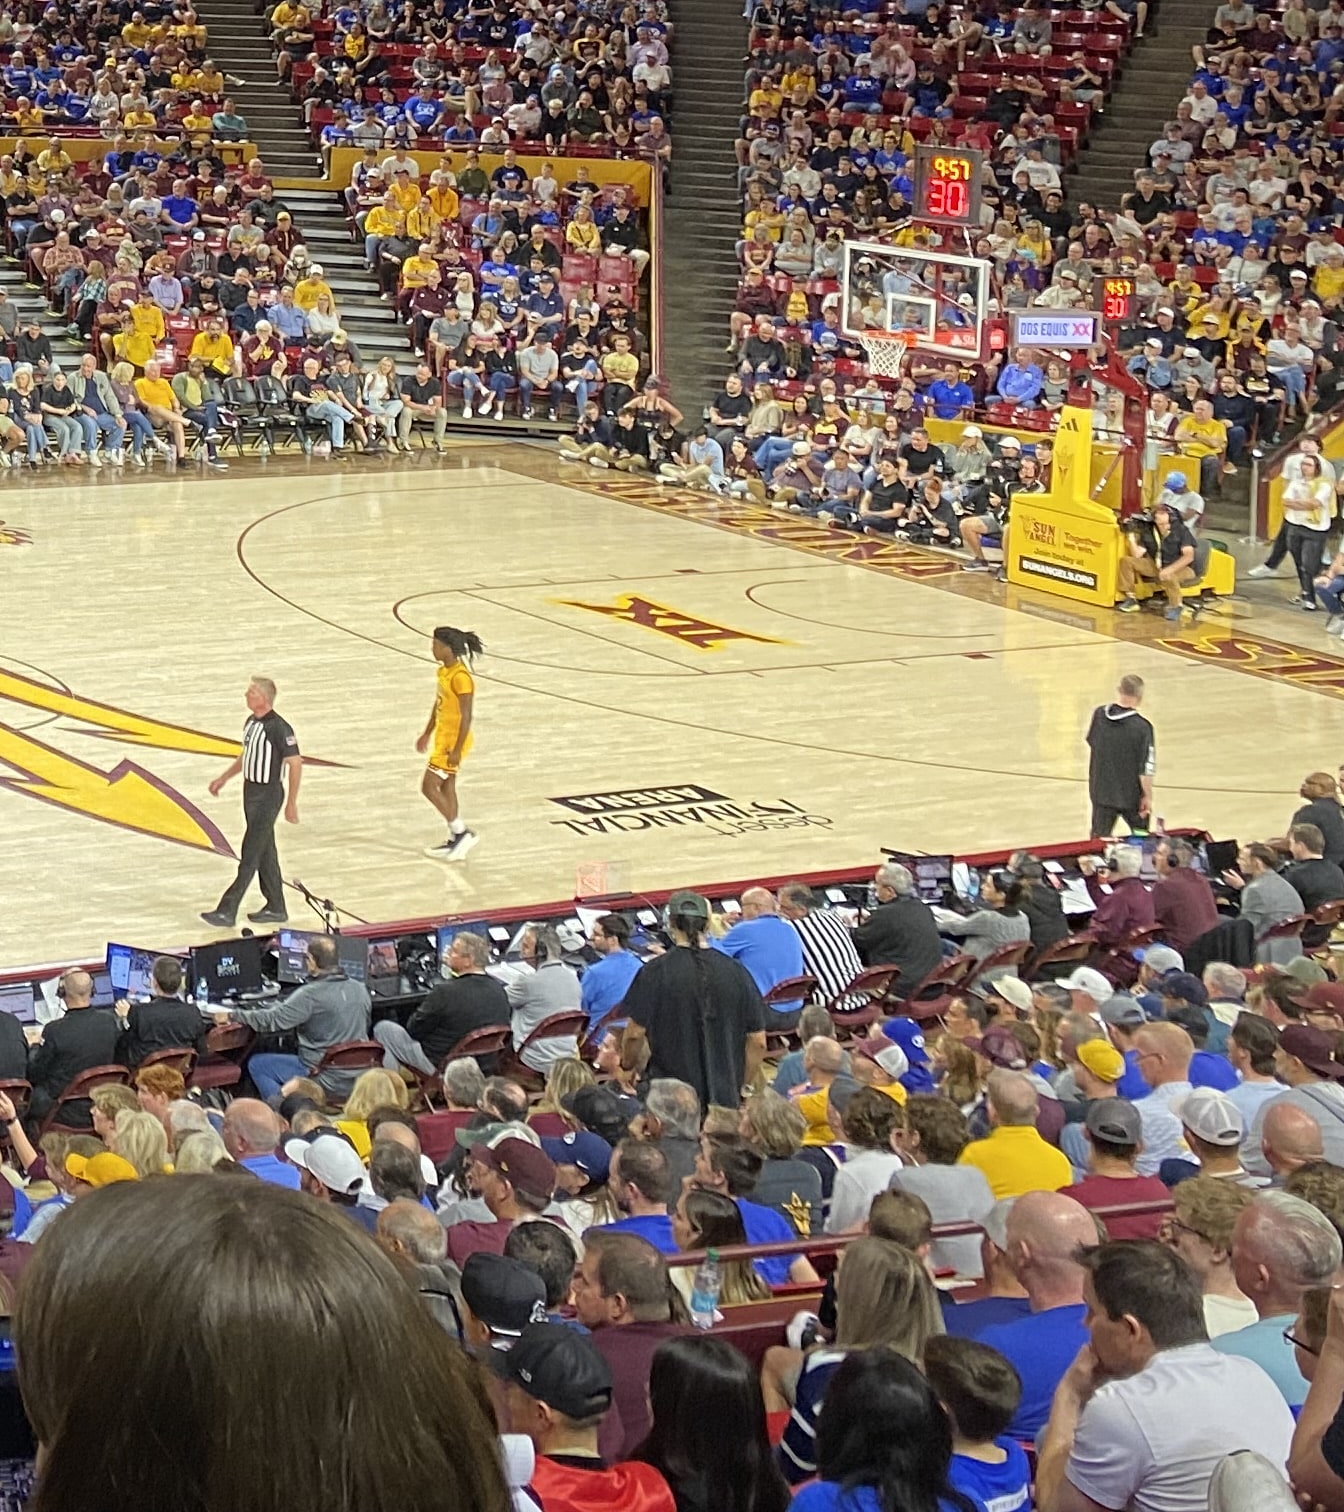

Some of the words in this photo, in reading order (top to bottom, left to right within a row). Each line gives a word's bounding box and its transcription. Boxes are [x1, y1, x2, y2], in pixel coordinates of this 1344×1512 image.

[934, 157, 970, 180] 9:57
[929, 179, 965, 216] 30
[1106, 281, 1131, 296] 9:57
[1106, 297, 1127, 319] 30
[1021, 322, 1039, 335] DOS
[1041, 321, 1068, 336] EQUIS
[1073, 323, 1090, 336] XX
[1029, 532, 1056, 546] ANGEL
[1034, 522, 1055, 536] SUN
[1023, 560, 1095, 586] SUNANGELS.ORG
[568, 788, 704, 810] ARENA
[705, 814, 834, 838] desert
